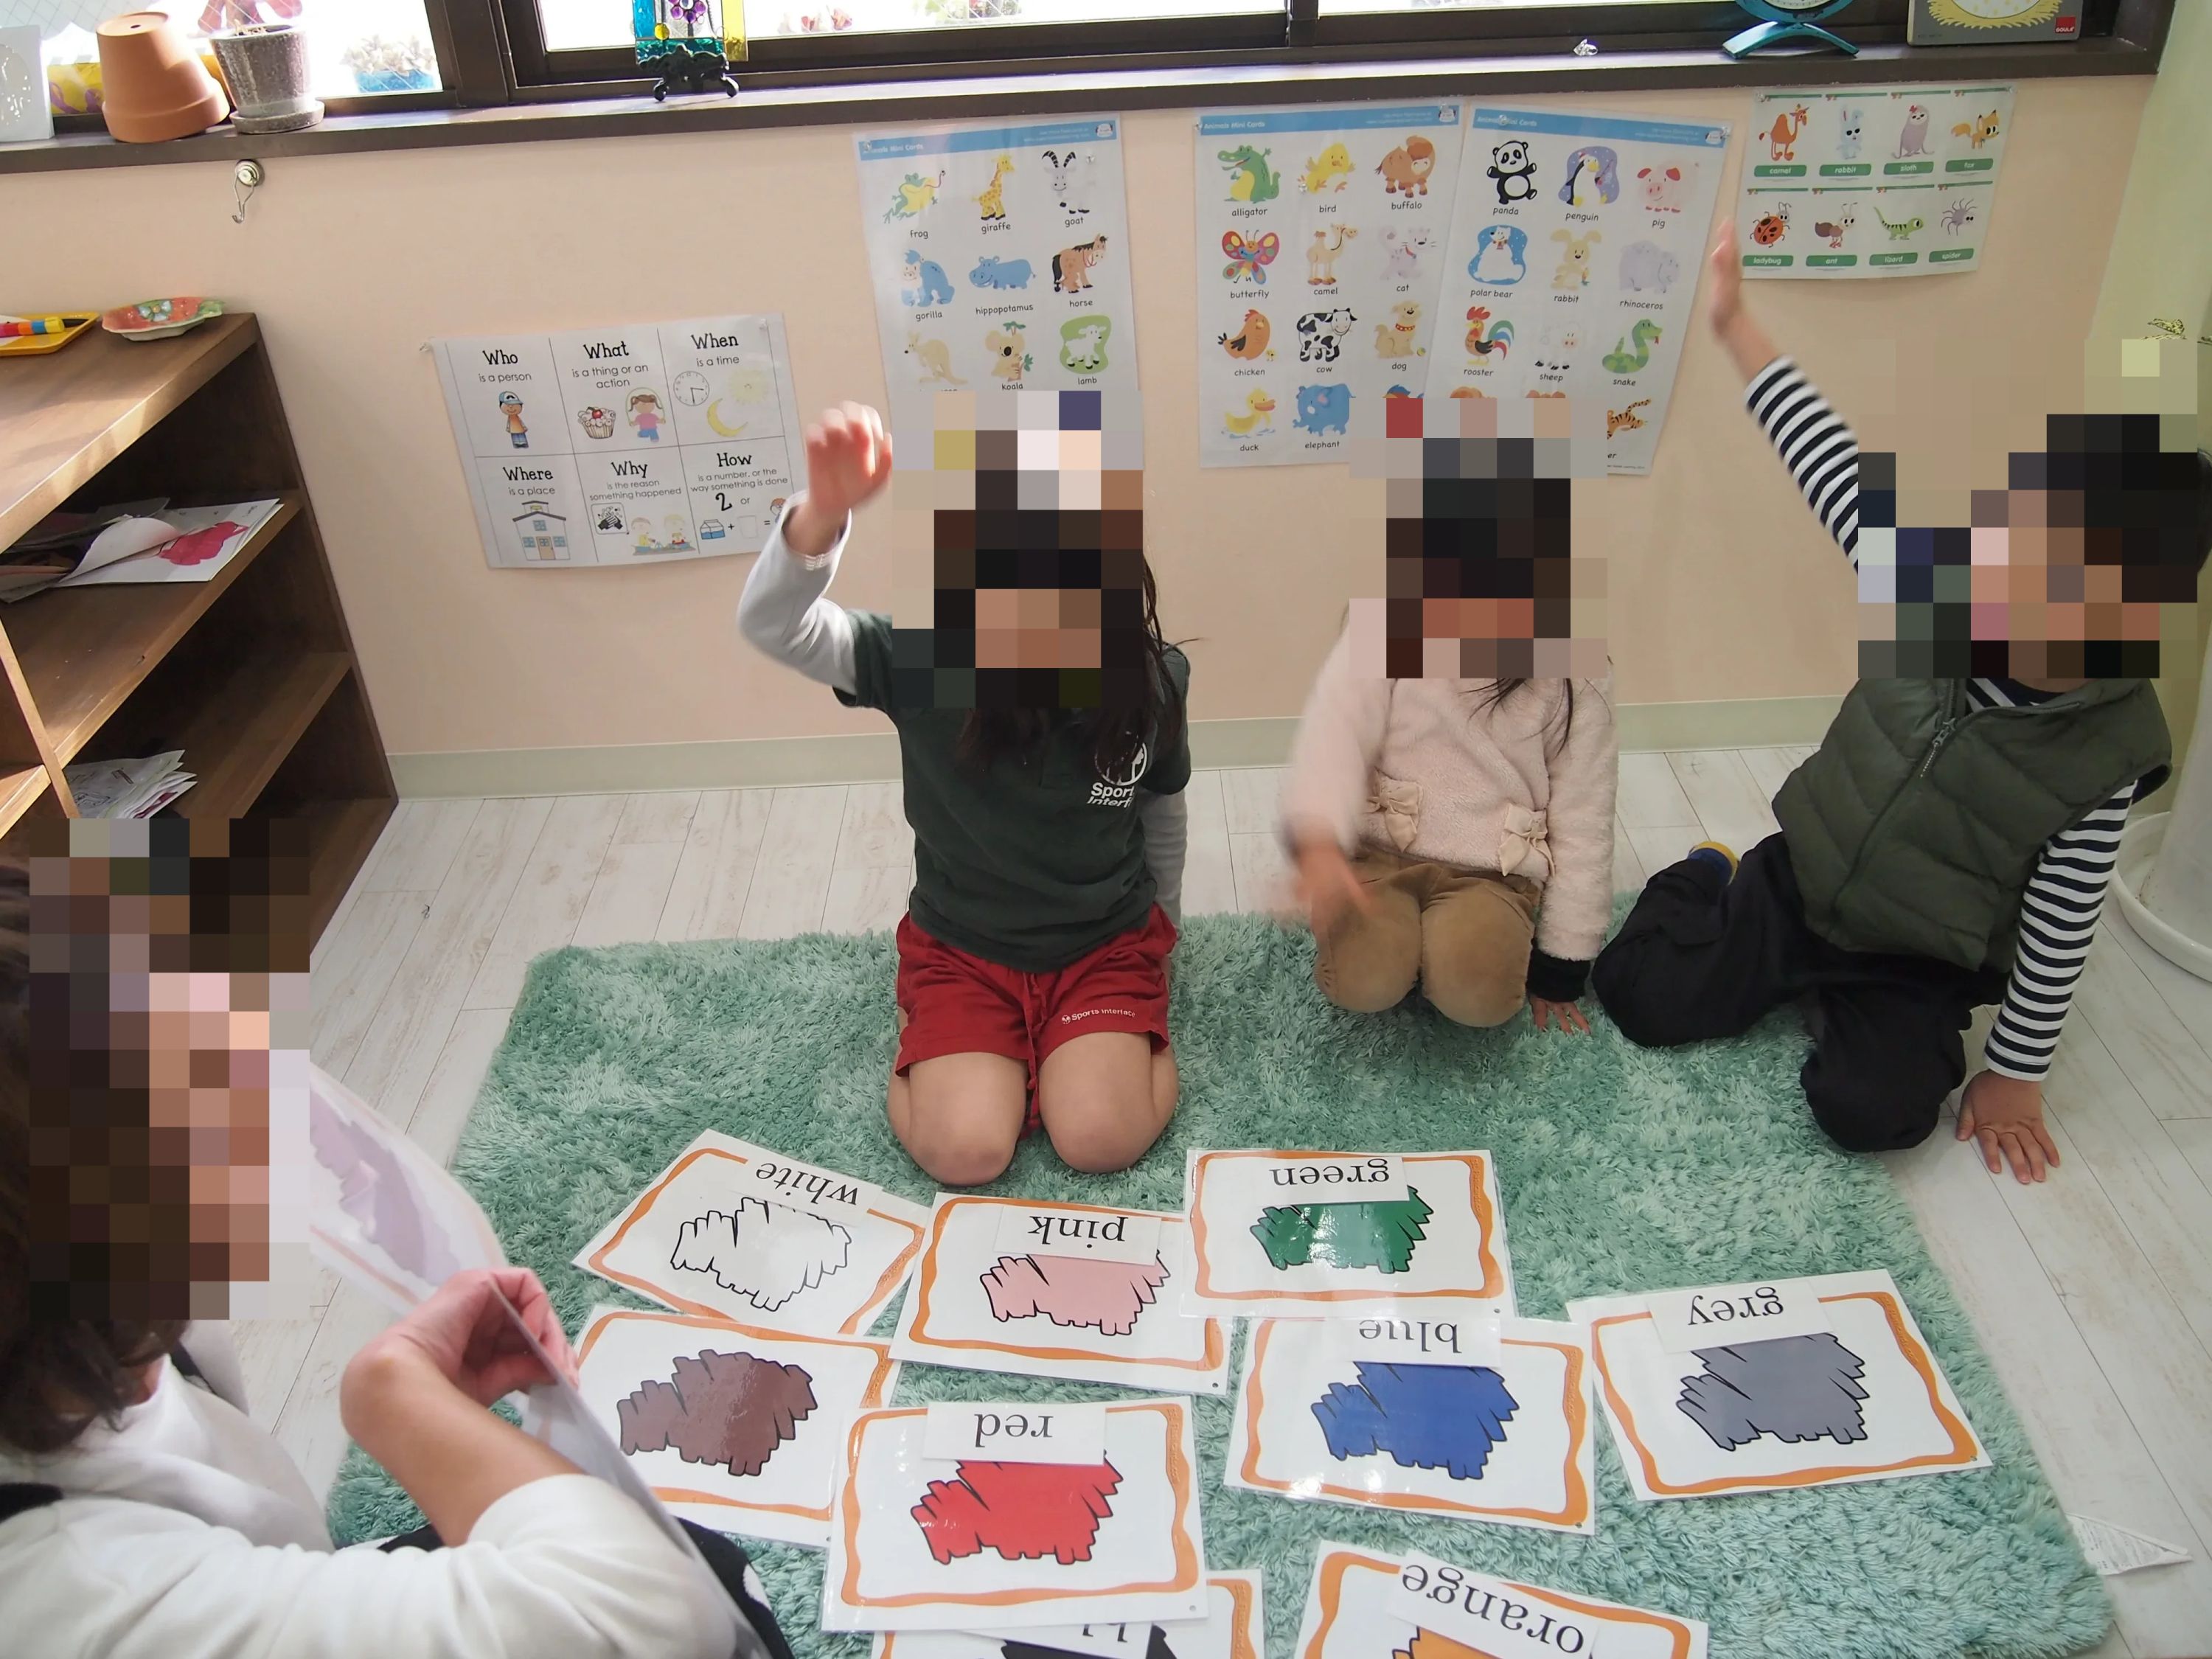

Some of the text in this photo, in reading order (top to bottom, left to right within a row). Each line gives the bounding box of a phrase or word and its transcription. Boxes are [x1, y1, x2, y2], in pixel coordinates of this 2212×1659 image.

[1900, 164, 1917, 172] sloth
[1964, 161, 1975, 170] fox
[1319, 204, 1337, 212] bird
[1391, 201, 1422, 210] buffalo
[1492, 206, 1519, 216] panda
[1231, 207, 1267, 218] alligator
[1565, 212, 1599, 223] penguin
[1065, 218, 1084, 227] goat
[1652, 218, 1666, 229] pig
[981, 223, 1011, 234] giraffe
[910, 229, 928, 240] frog
[1753, 257, 1781, 265] ladybug
[1885, 255, 1903, 263] lizard
[1941, 251, 1961, 260] spider
[1230, 289, 1269, 299] butterfly
[1314, 287, 1338, 295] camel
[1470, 289, 1492, 299] polar
[1069, 299, 1093, 307] horse
[1554, 294, 1579, 303] rabbit
[975, 303, 1034, 316] hippopotamus
[1619, 299, 1663, 310] rhinoceros
[916, 310, 942, 321] gorilla
[692, 334, 739, 349] When
[583, 341, 630, 359] What
[482, 349, 518, 365] Who
[696, 357, 703, 366] is
[714, 355, 740, 365] time
[572, 368, 580, 378] is
[591, 365, 618, 377] thing
[622, 366, 631, 375] or
[634, 364, 648, 373] an
[1234, 368, 1265, 376] chicken
[1392, 362, 1407, 371] dog
[479, 373, 486, 382] is
[497, 372, 532, 383] person
[1464, 369, 1494, 378] rooster
[1540, 373, 1563, 382] sheep
[596, 378, 630, 389] action
[1078, 376, 1097, 385] lamb
[1613, 378, 1636, 386] snake
[1001, 383, 1023, 391] koala
[1304, 440, 1340, 450] elephant
[717, 453, 753, 467] How
[503, 467, 554, 481] Where
[611, 462, 647, 478] Why
[763, 467, 777, 476] the
[607, 479, 660, 490] is the reason
[691, 476, 788, 493] way something is done
[508, 486, 515, 495] is
[527, 486, 555, 496] place
[589, 488, 681, 502] something happened
[714, 493, 751, 511] 2 or
[1087, 796, 1133, 808] Interf
[1071, 1009, 1099, 1020] Sports
[1270, 1158, 1390, 1186] green
[755, 1161, 860, 1206] white
[1028, 1214, 1129, 1249] pink
[1687, 1286, 1785, 1326] grey
[1359, 1318, 1462, 1354] blue
[973, 1413, 1053, 1448] red
[1401, 1563, 1585, 1654] orange
